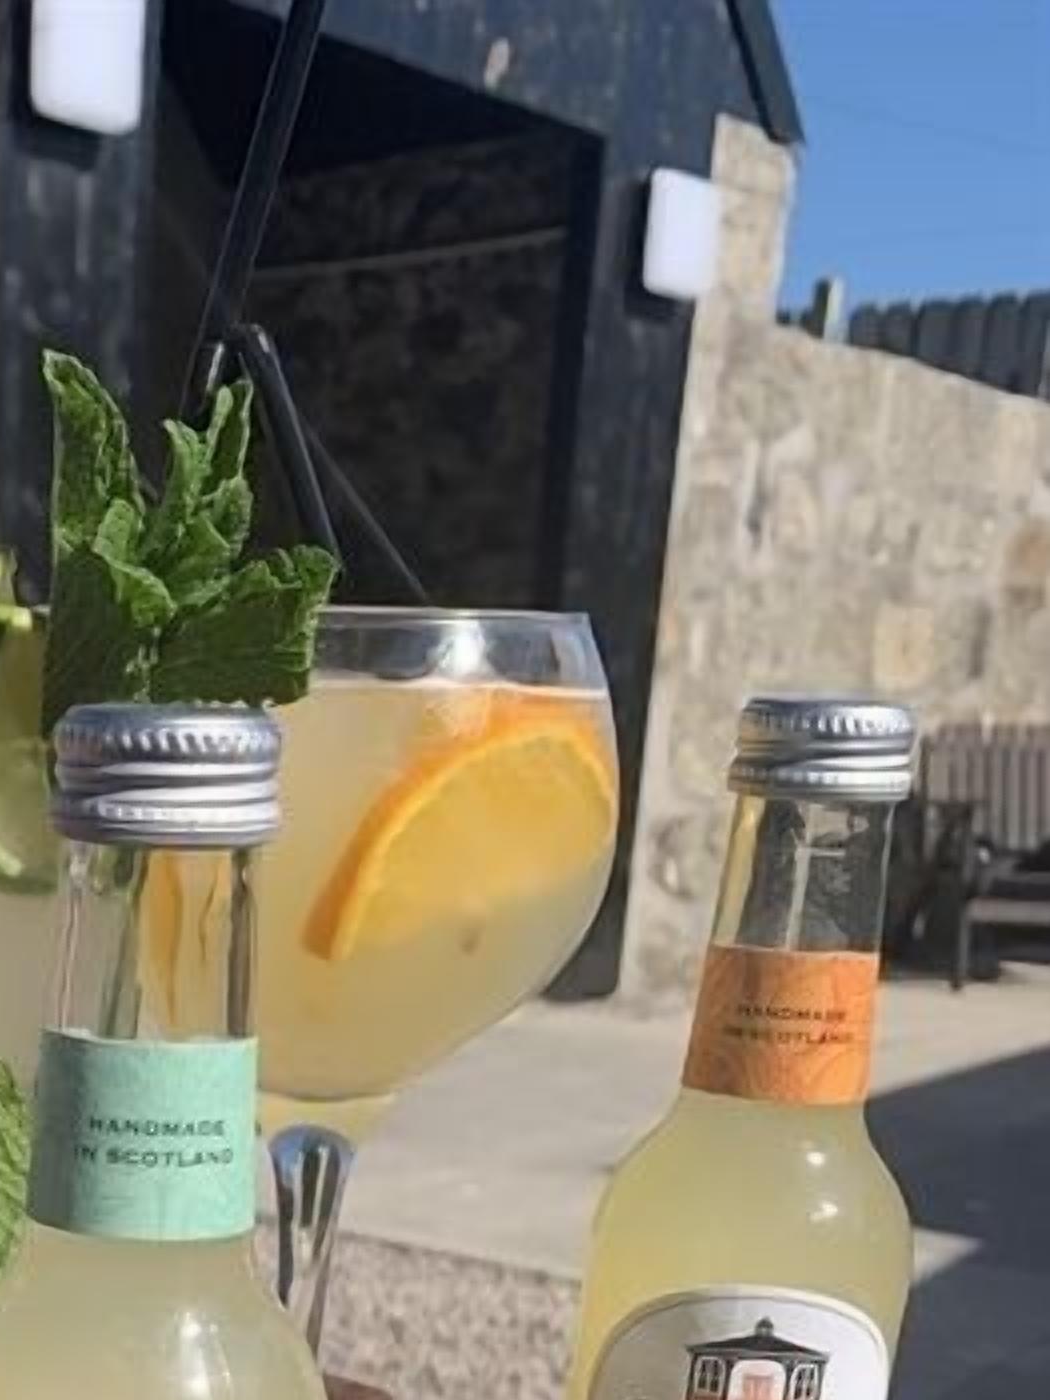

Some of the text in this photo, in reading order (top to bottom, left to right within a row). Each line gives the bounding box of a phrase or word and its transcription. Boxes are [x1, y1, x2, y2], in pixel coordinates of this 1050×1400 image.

[88, 1115, 227, 1136] HANDMADE
[73, 1144, 234, 1168] IN SCOTLAND
